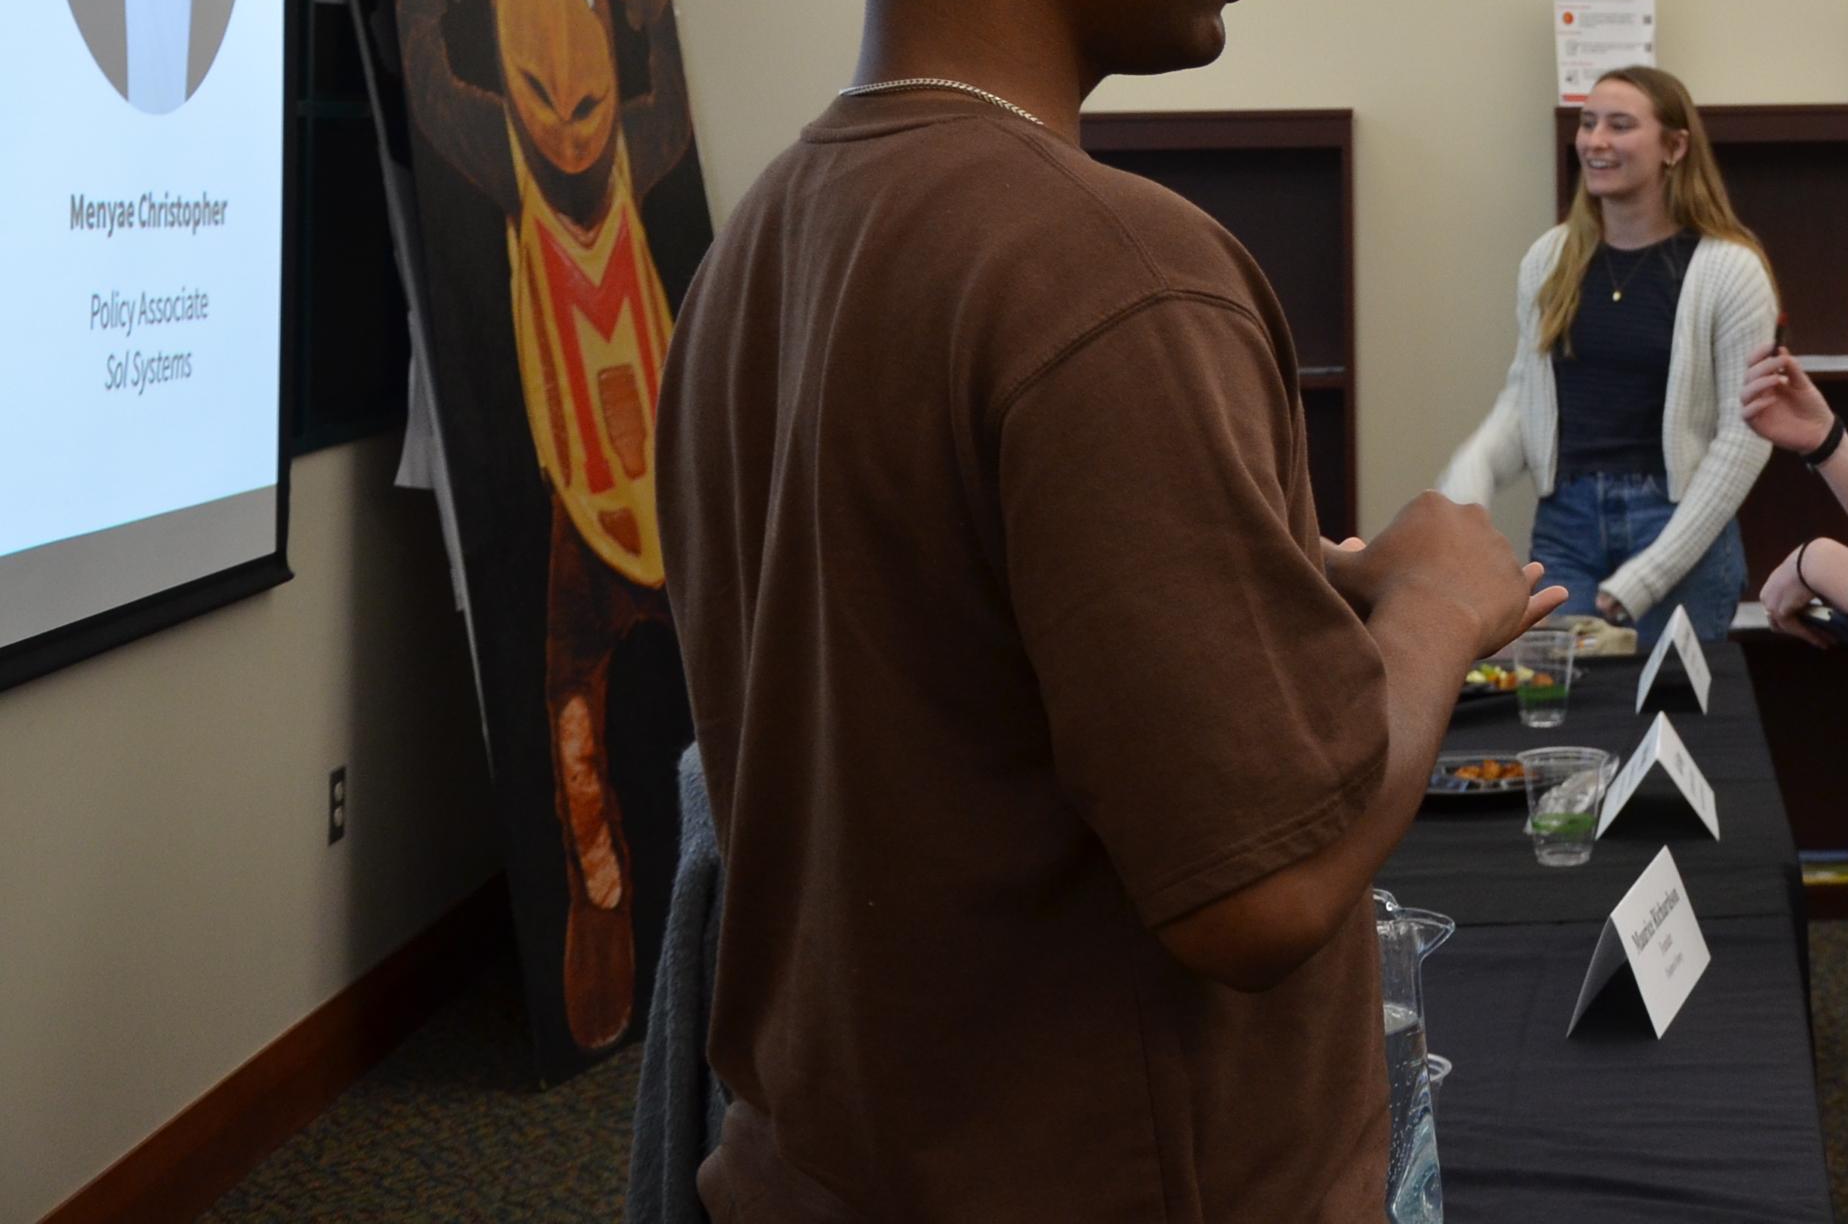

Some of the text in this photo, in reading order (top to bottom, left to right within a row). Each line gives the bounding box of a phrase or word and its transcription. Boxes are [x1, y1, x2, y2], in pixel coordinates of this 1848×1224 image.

[70, 191, 228, 238] Menyae Christopher
[90, 287, 209, 337] Policy Associate
[105, 349, 193, 396] Sol Systems
